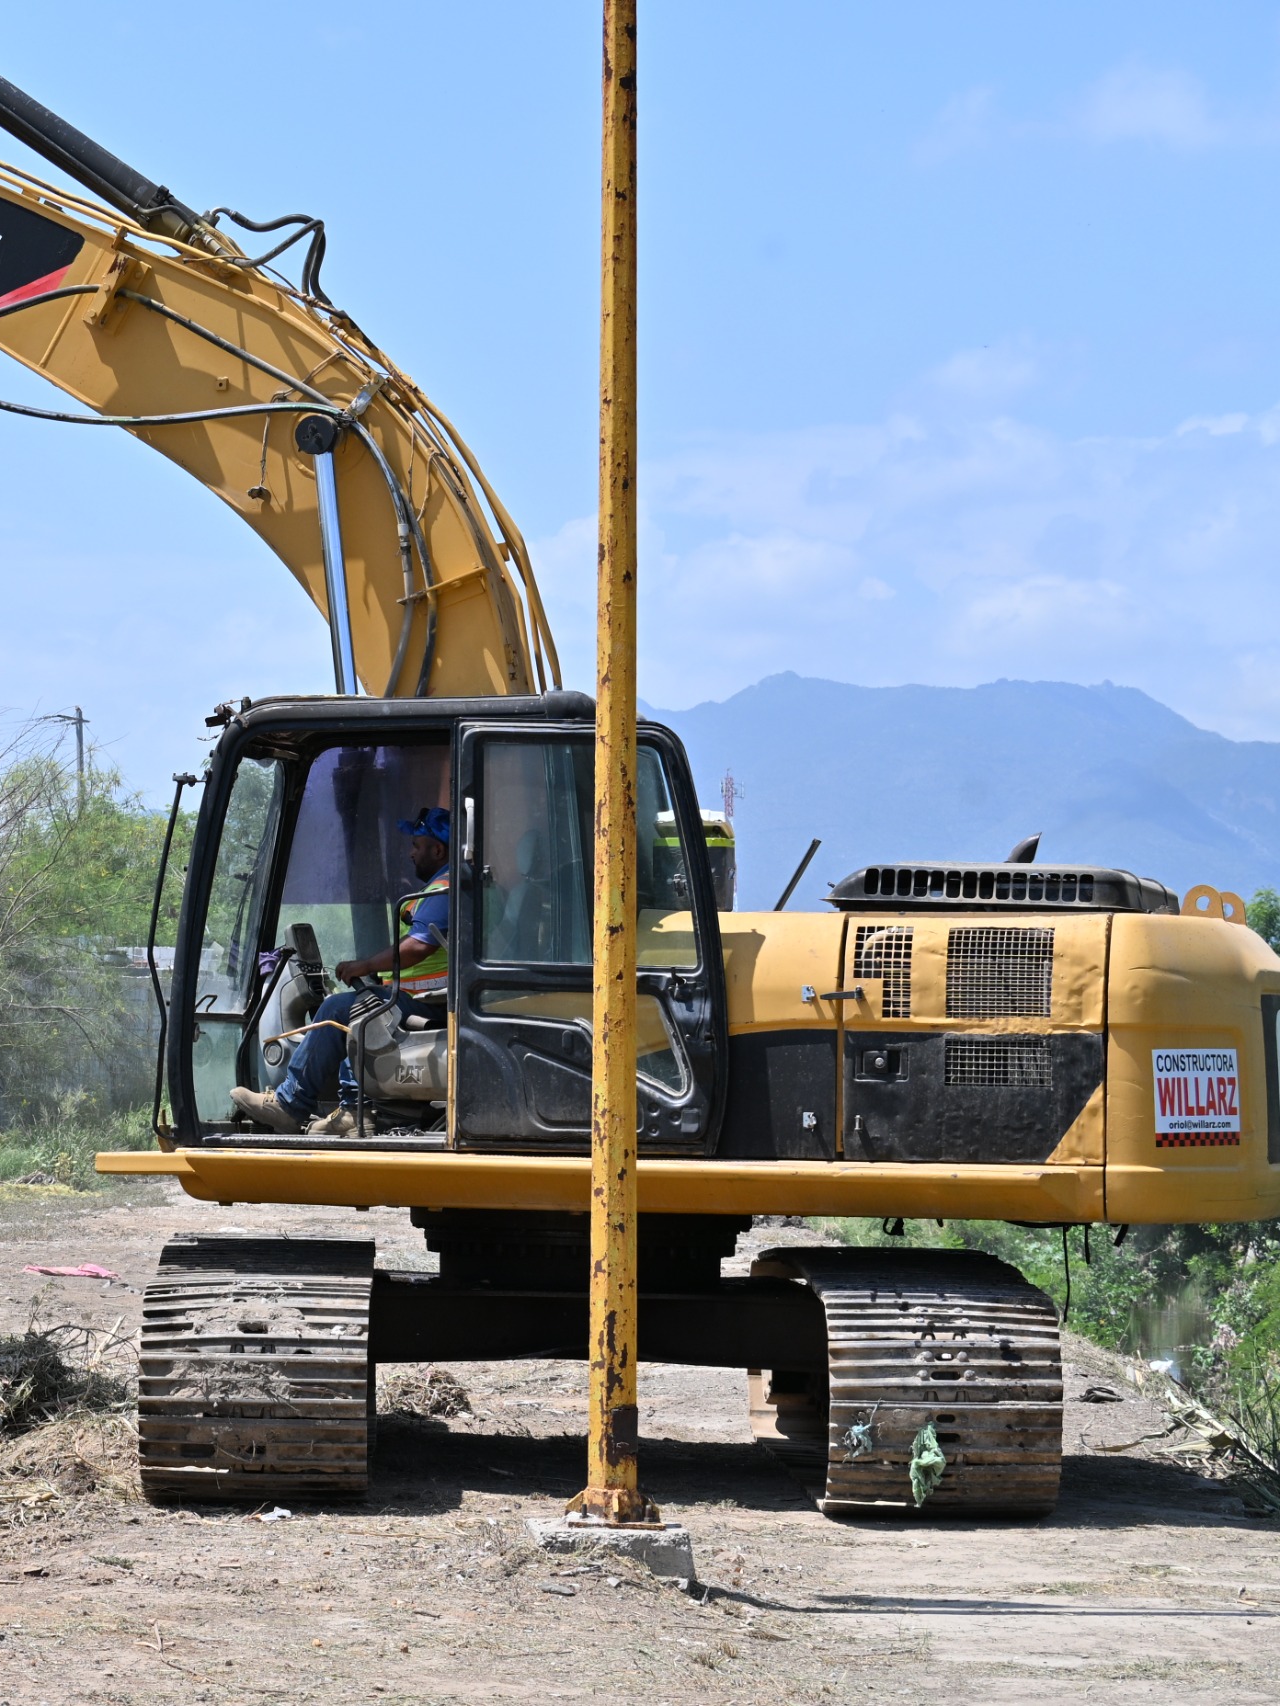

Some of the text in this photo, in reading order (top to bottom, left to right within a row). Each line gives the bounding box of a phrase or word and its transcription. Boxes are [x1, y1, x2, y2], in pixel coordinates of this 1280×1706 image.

[1156, 1054, 1234, 1072] CONSTRUCTORA
[395, 1065, 425, 1084] CAT
[1157, 1077, 1238, 1117] WILLARZ
[1169, 1120, 1231, 1130] oriol@willarz.com
